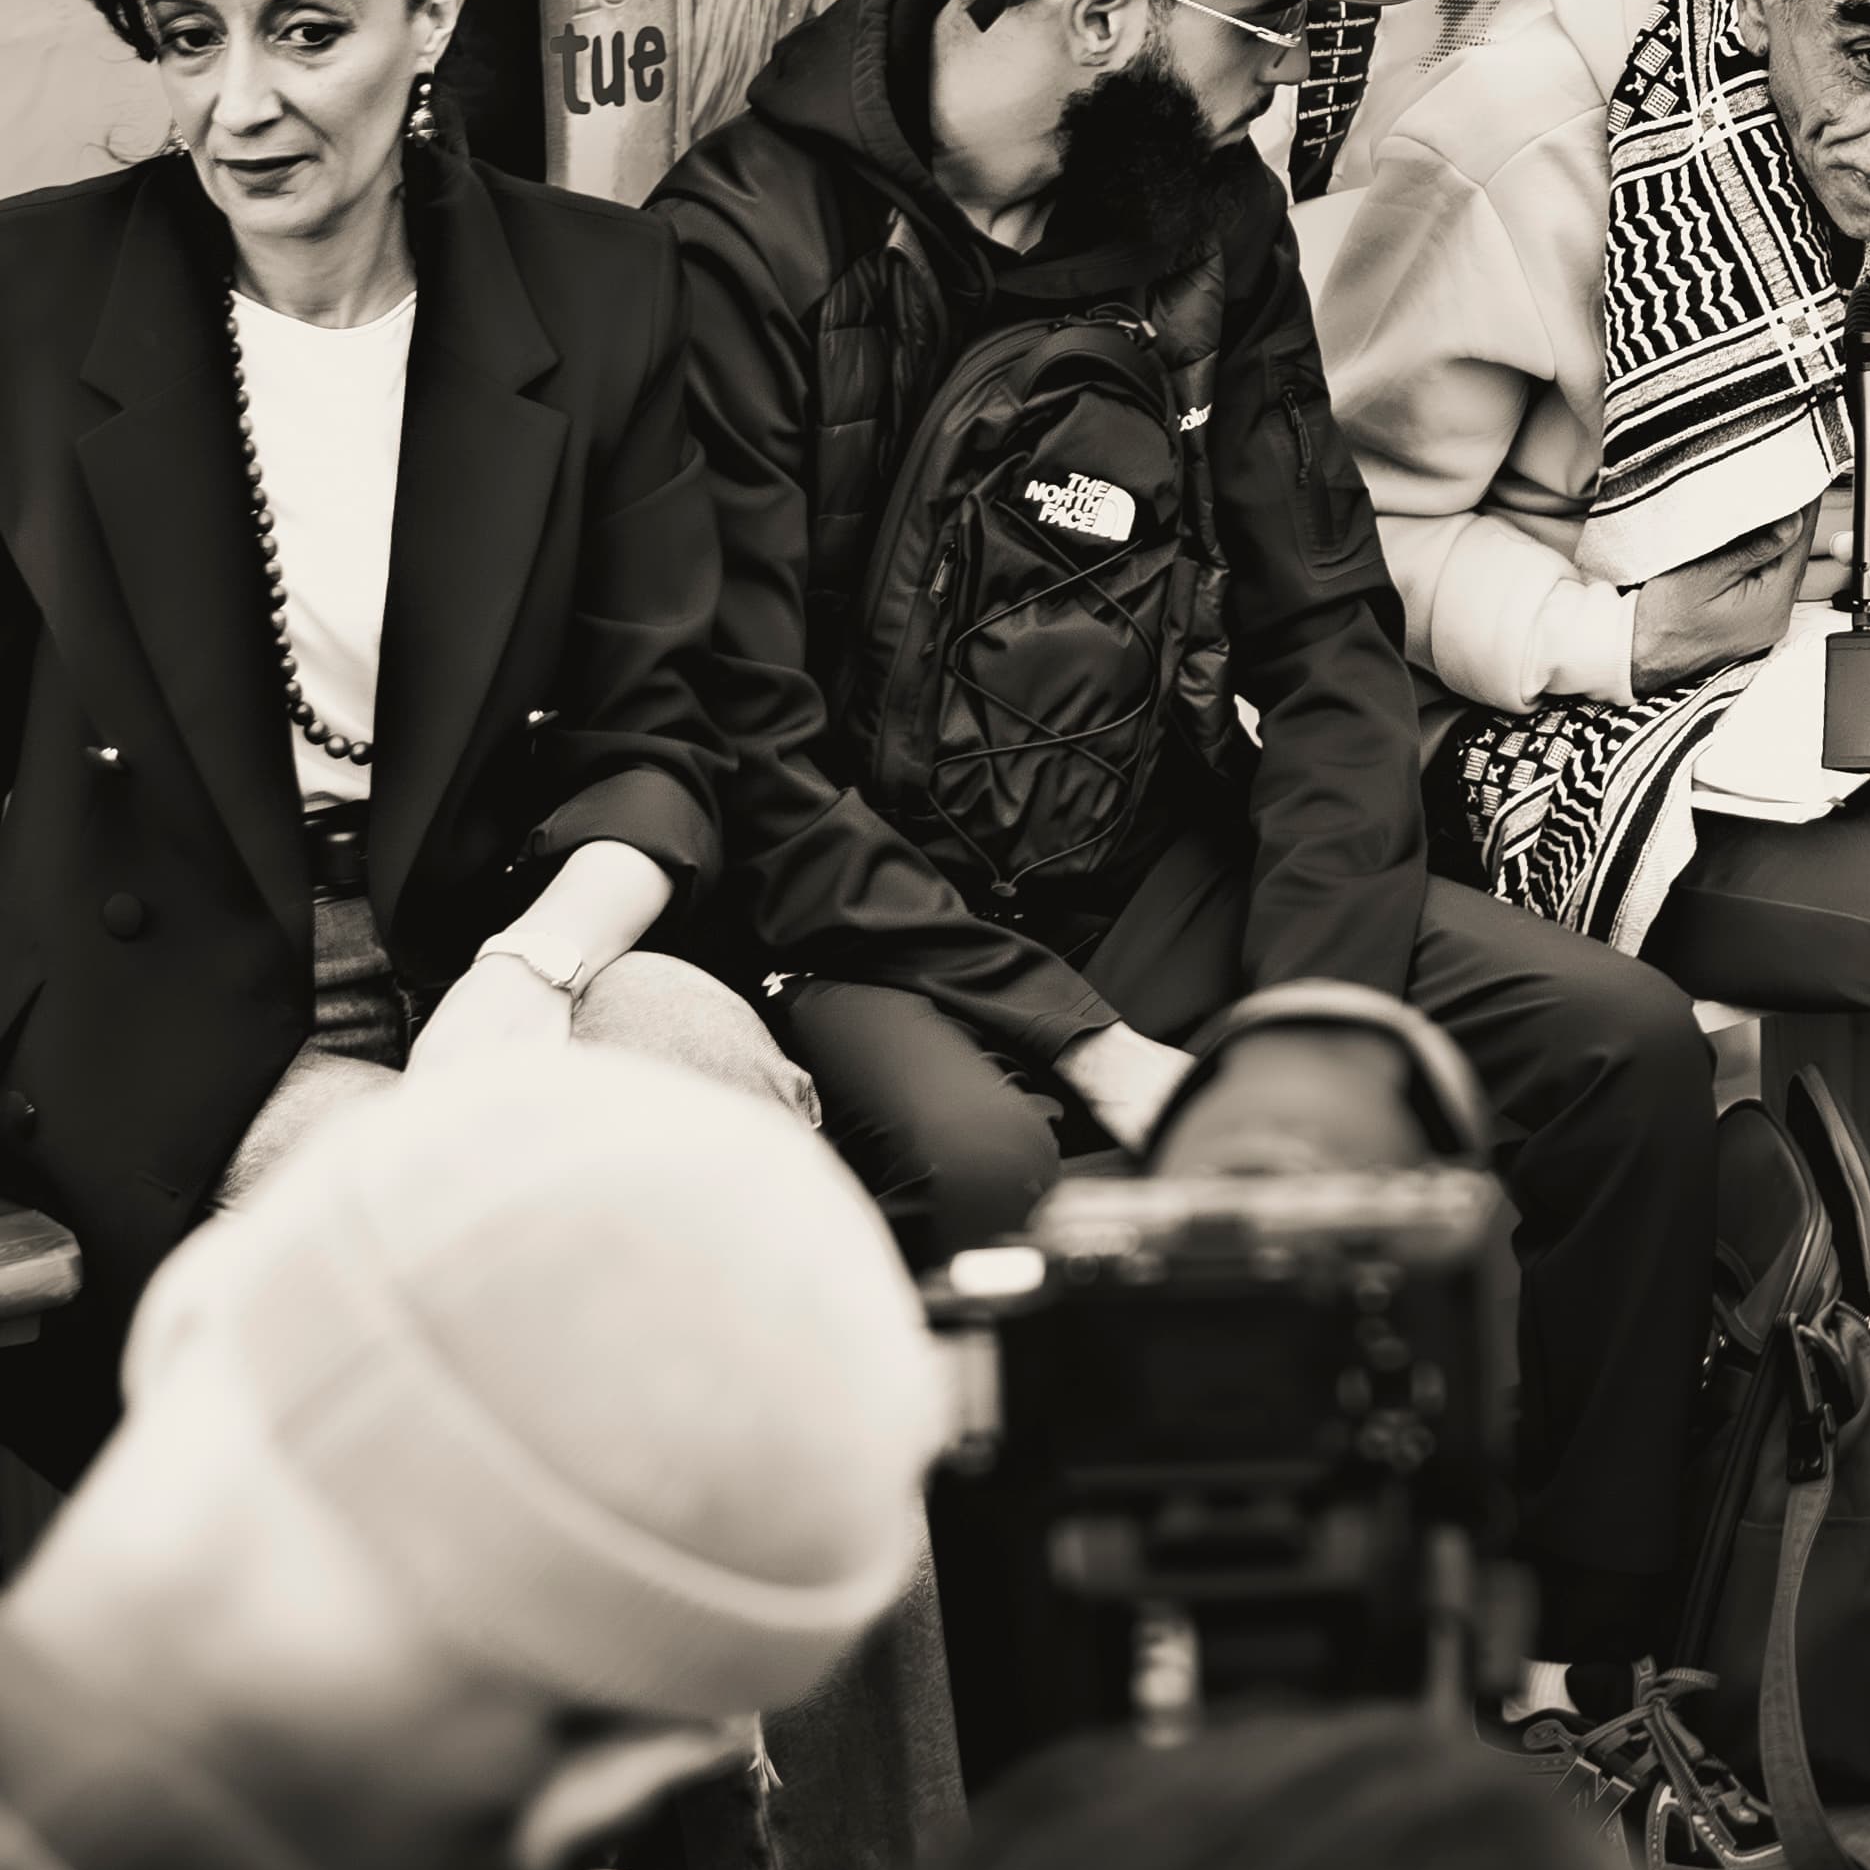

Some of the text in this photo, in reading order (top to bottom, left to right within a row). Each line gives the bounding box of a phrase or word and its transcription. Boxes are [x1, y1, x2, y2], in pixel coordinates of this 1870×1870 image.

[549, 21, 668, 117] tue
[1024, 480, 1105, 514] NORTH
[1067, 472, 1112, 498] THE
[1038, 502, 1098, 532] FACE
